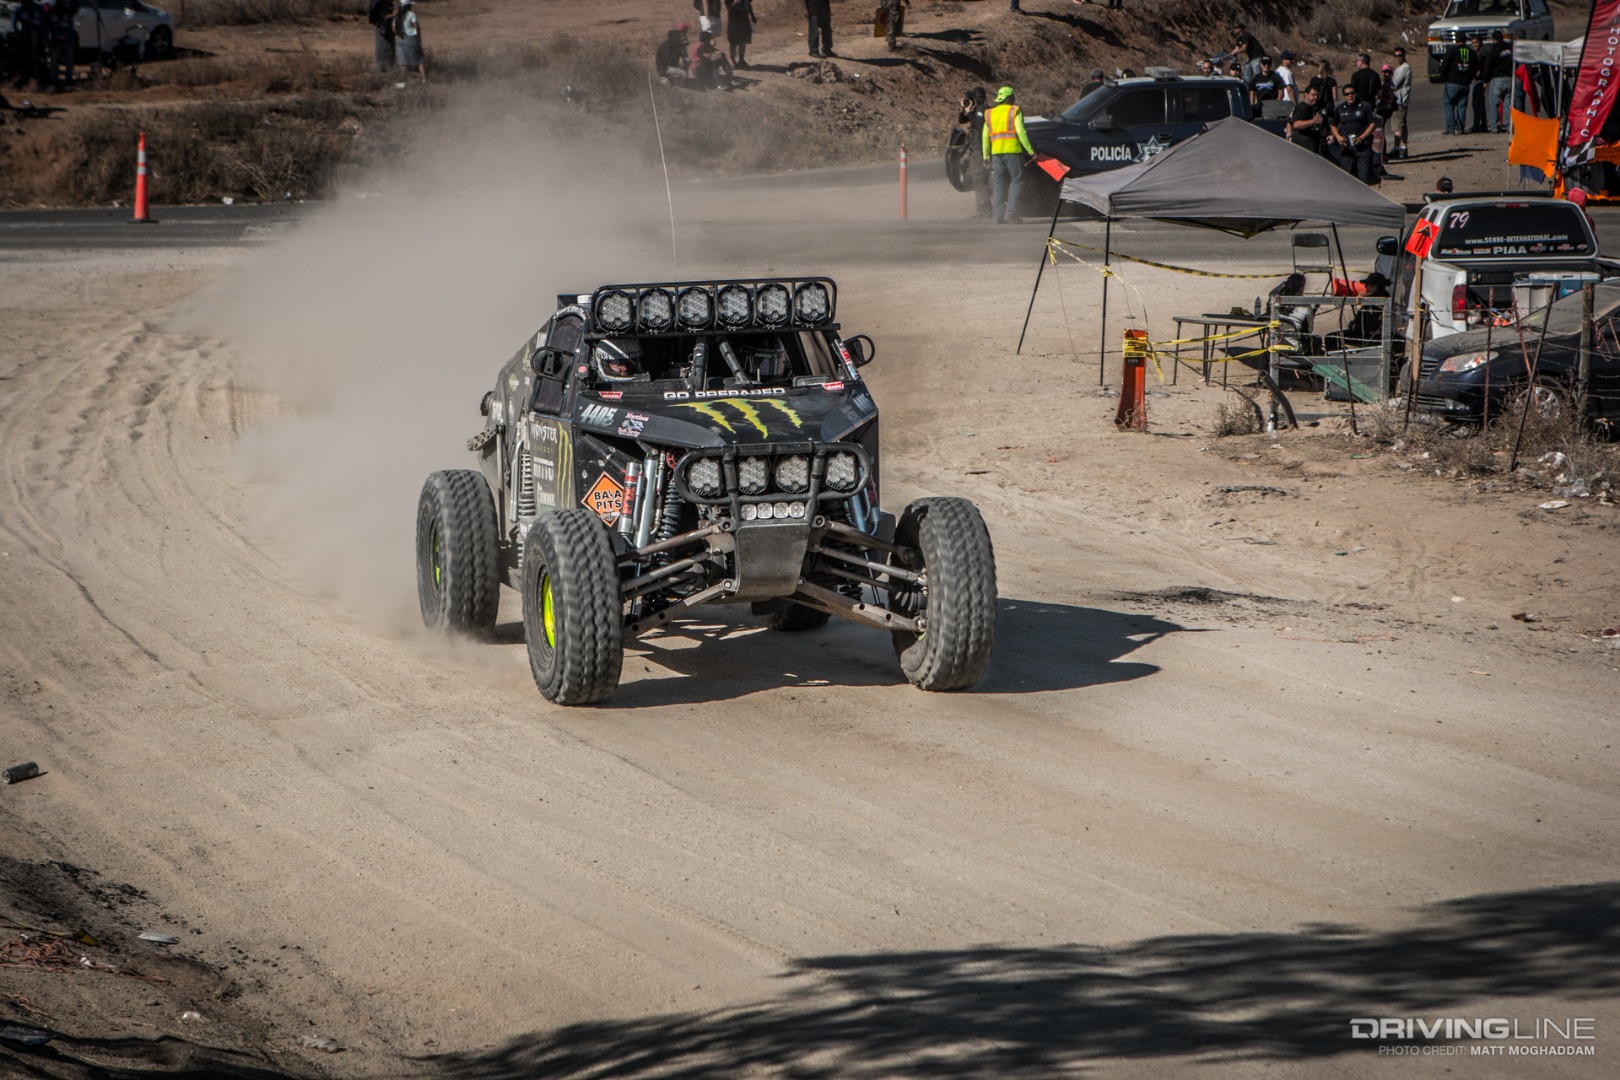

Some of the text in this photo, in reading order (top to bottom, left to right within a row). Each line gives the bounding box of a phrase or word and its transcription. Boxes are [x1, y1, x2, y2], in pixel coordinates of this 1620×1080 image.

[1580, 16, 1620, 137] PHOTOGRAPHIC
[1091, 144, 1132, 161] POLICÍA
[1449, 211, 1470, 229] 79
[1493, 245, 1528, 255] PIAA
[664, 387, 786, 400] GO PREPARED
[580, 403, 619, 427] 4405
[531, 420, 558, 444] MONSTER
[596, 500, 622, 510] PITS
